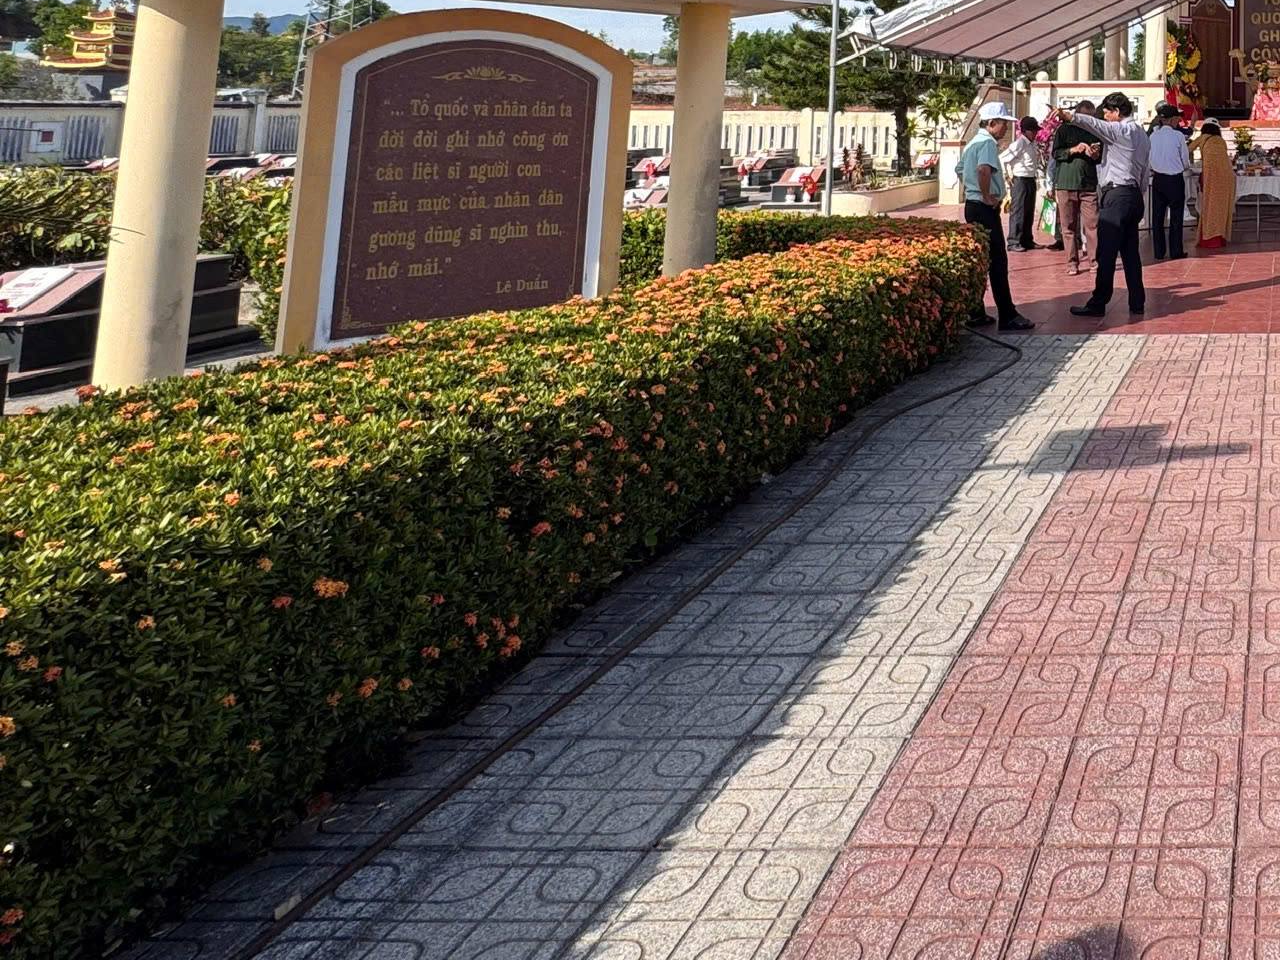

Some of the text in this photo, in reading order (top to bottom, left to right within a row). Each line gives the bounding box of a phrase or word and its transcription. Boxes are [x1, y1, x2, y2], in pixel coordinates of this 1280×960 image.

[410, 93, 430, 117] Tổ
[434, 97, 468, 120] quốc
[473, 100, 489, 117] và
[494, 100, 528, 117] nhân
[532, 100, 555, 117] dân
[560, 103, 572, 118] ta
[379, 130, 404, 148] đời
[412, 130, 438, 148] đời
[446, 130, 469, 152] ghi
[477, 131, 506, 148] nhớ
[513, 131, 546, 151] công
[376, 162, 403, 181] các
[412, 161, 439, 183] liệt
[469, 160, 509, 184] người
[517, 163, 541, 177] con
[417, 195, 451, 215] mực
[459, 190, 486, 210] của
[494, 192, 530, 208] nhân
[538, 188, 564, 206] dân
[489, 221, 529, 244] nghìn
[365, 261, 400, 281] nhớ
